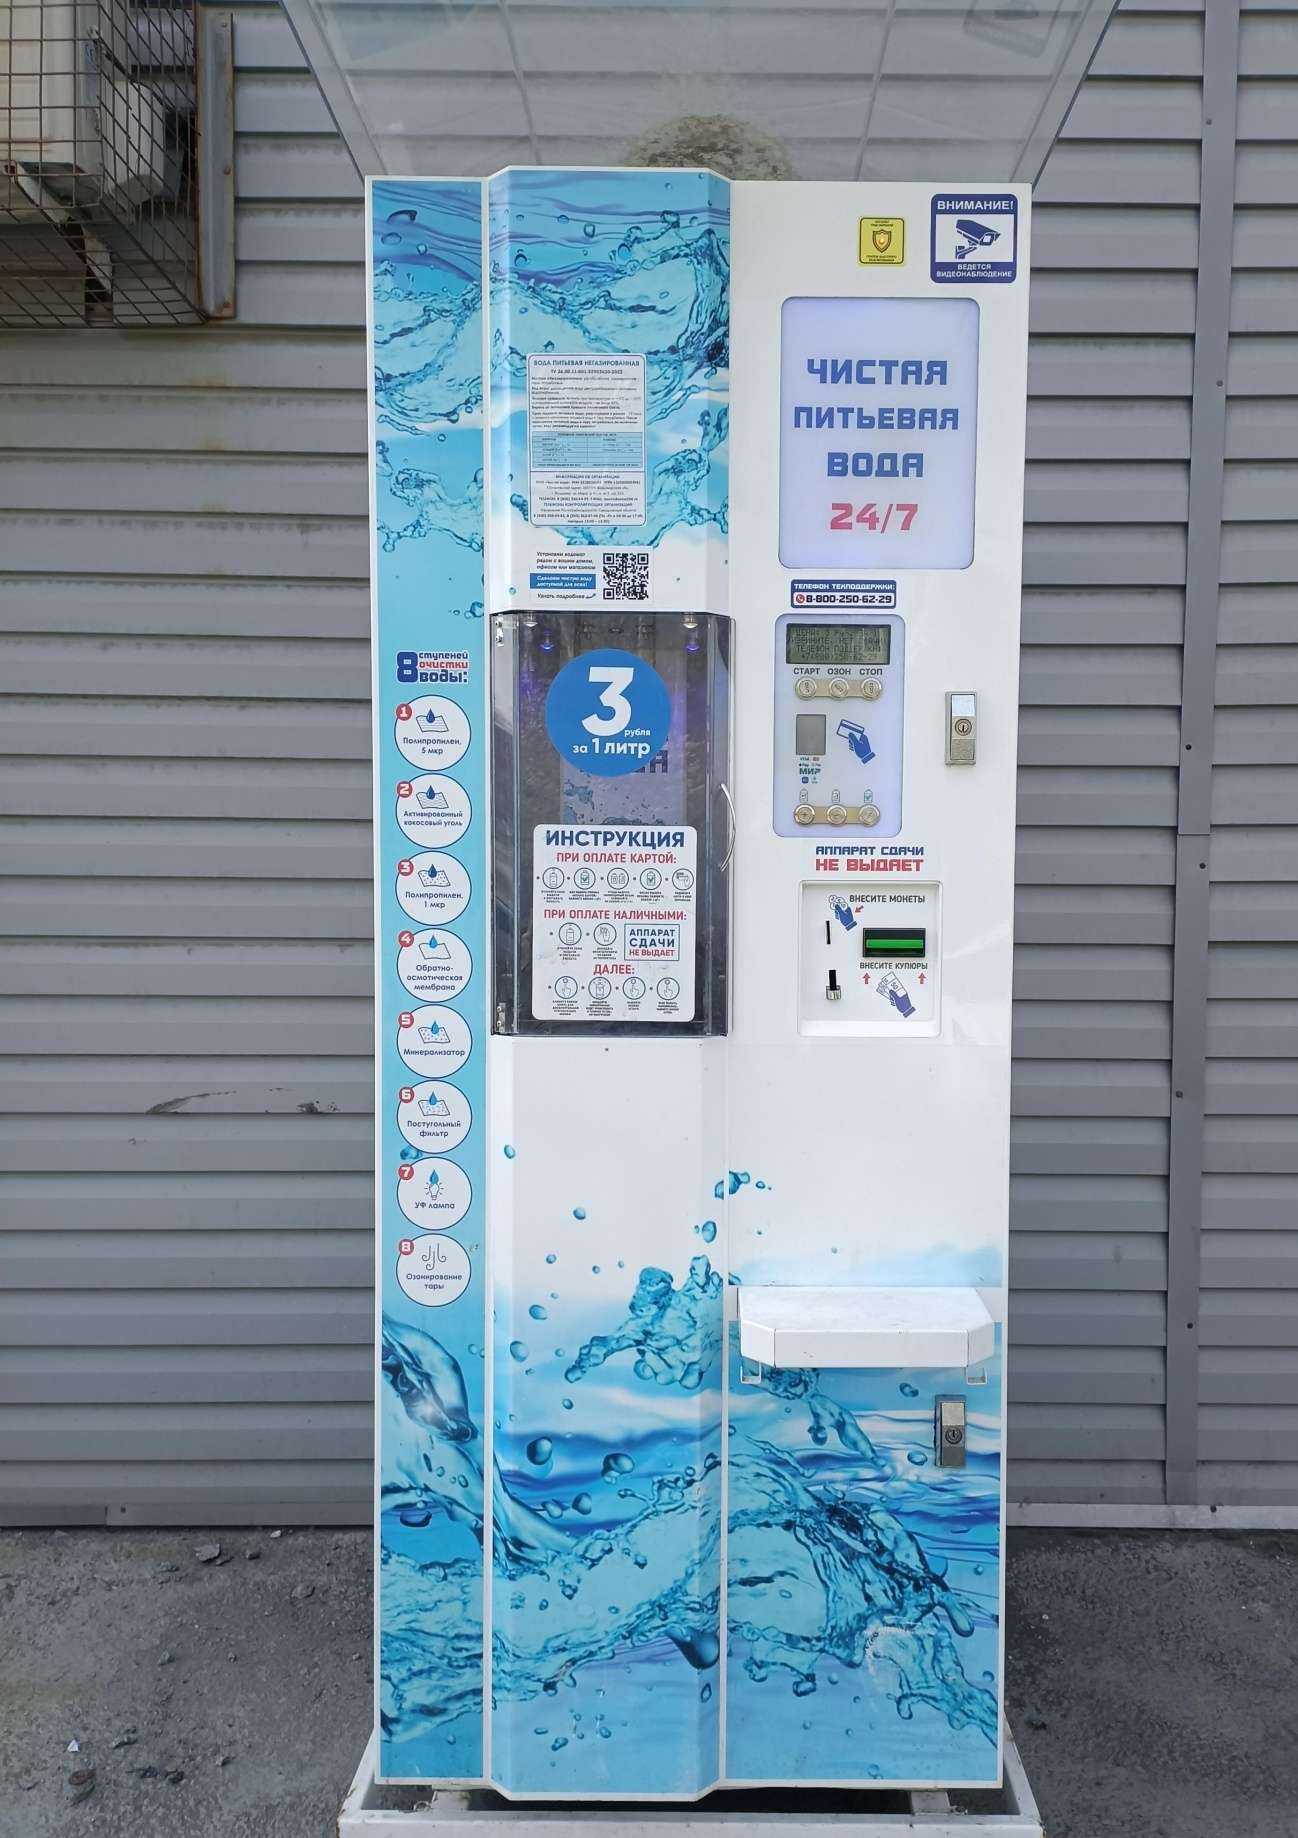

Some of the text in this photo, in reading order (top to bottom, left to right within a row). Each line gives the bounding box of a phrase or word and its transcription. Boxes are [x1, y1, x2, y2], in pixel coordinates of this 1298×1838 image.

[937, 200, 1014, 210] ВНИМАНИЕ!
[806, 358, 948, 385] ЧИСТАЯ
[794, 406, 960, 430] ПИТЬЕВАЯ
[826, 452, 924, 478] ВОДА
[830, 502, 920, 534] 24/7
[805, 595, 892, 604] 8-800-250-62-29
[419, 651, 468, 661] ступеней
[397, 652, 418, 683] 8
[419, 660, 468, 669] очистки
[419, 669, 468, 683] воды:
[582, 666, 634, 736] 3
[400, 706, 408, 717] 1
[624, 728, 651, 737] рубля
[403, 737, 462, 747] Полипропилен,
[572, 738, 651, 758] за 1 литр
[400, 784, 409, 795] 2
[403, 810, 463, 818] Активированный
[546, 830, 685, 849] ИНСТРУКЦИЯ
[816, 846, 924, 856] АППАРАТ СДАЧИ
[556, 852, 677, 864] ПРИ ОПЛАТЕ КАРТОЙ:
[401, 863, 410, 873] 3
[816, 859, 924, 872] НЕ ВЫДАЕТ
[405, 891, 463, 902] Полипропилен,
[849, 895, 925, 903] ВНЕСИТЕ МОНЕТЫ
[544, 910, 687, 920] ПРИ ОПЛАТЕ НАЛИЧНЫМИ:
[629, 928, 676, 937] АППАРАТ
[401, 934, 411, 944] 4
[629, 938, 675, 948] СДАЧИ
[416, 964, 453, 973] Обратно-
[593, 964, 635, 975] ДАЛЕЕ:
[401, 1015, 411, 1025] 5
[404, 1049, 465, 1057] Минерализатор
[407, 1120, 461, 1129] Постугольный
[402, 1167, 410, 1178] 7
